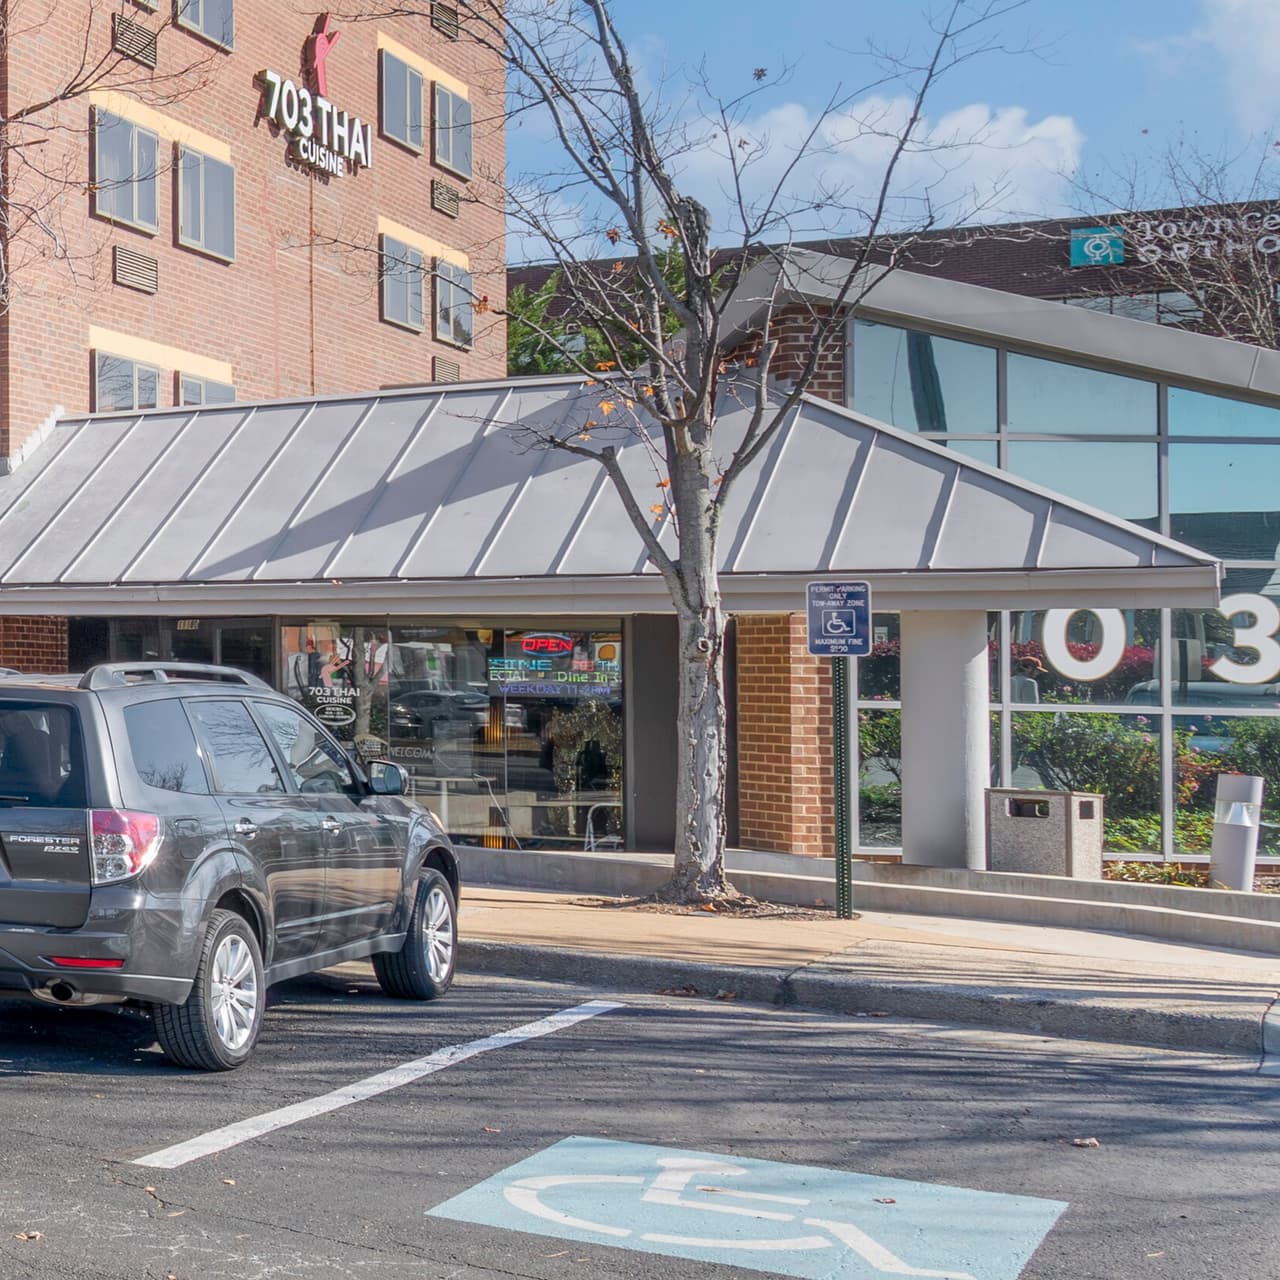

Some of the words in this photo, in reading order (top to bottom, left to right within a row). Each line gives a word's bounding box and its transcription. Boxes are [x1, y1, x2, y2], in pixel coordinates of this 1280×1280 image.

[262, 69, 314, 138] 703
[316, 95, 372, 169] THAI
[298, 137, 345, 178] CUISINE
[521, 638, 574, 652] OPEN
[308, 687, 331, 697] 703
[331, 687, 361, 697] THAI
[316, 696, 353, 705] CUISINE
[9, 835, 81, 845] FORESTER
